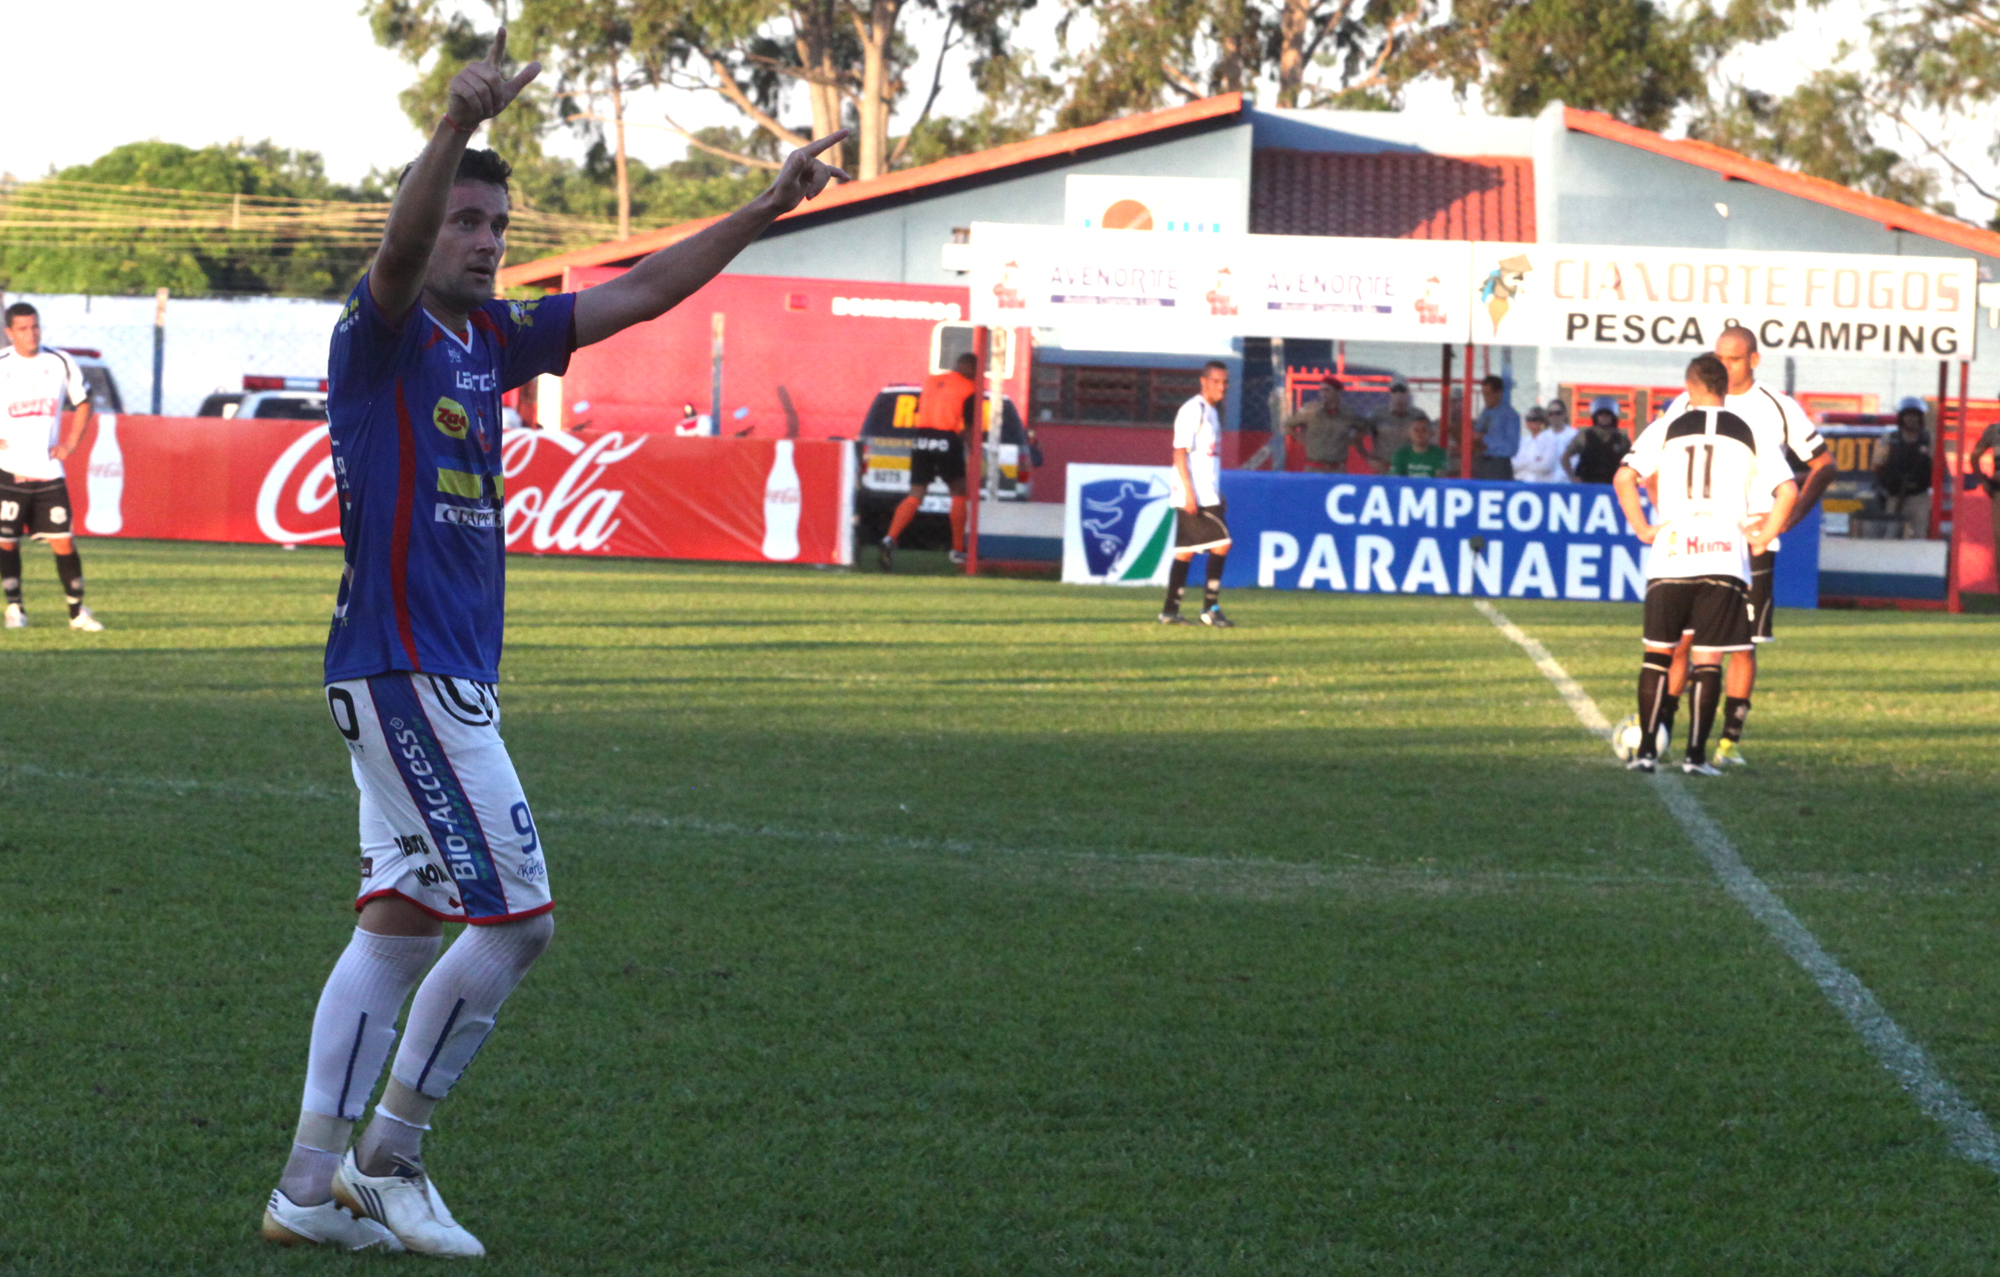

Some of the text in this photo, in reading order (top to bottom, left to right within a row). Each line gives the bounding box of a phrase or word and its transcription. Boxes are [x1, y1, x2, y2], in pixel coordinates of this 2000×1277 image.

[1553, 259, 1961, 312] CIANORTE FOGOS
[1566, 312, 1959, 355] PESCA CAMPING
[1684, 444, 1714, 500] 11
[1325, 484, 1659, 536] CAMPEONA
[510, 801, 537, 854] 9
